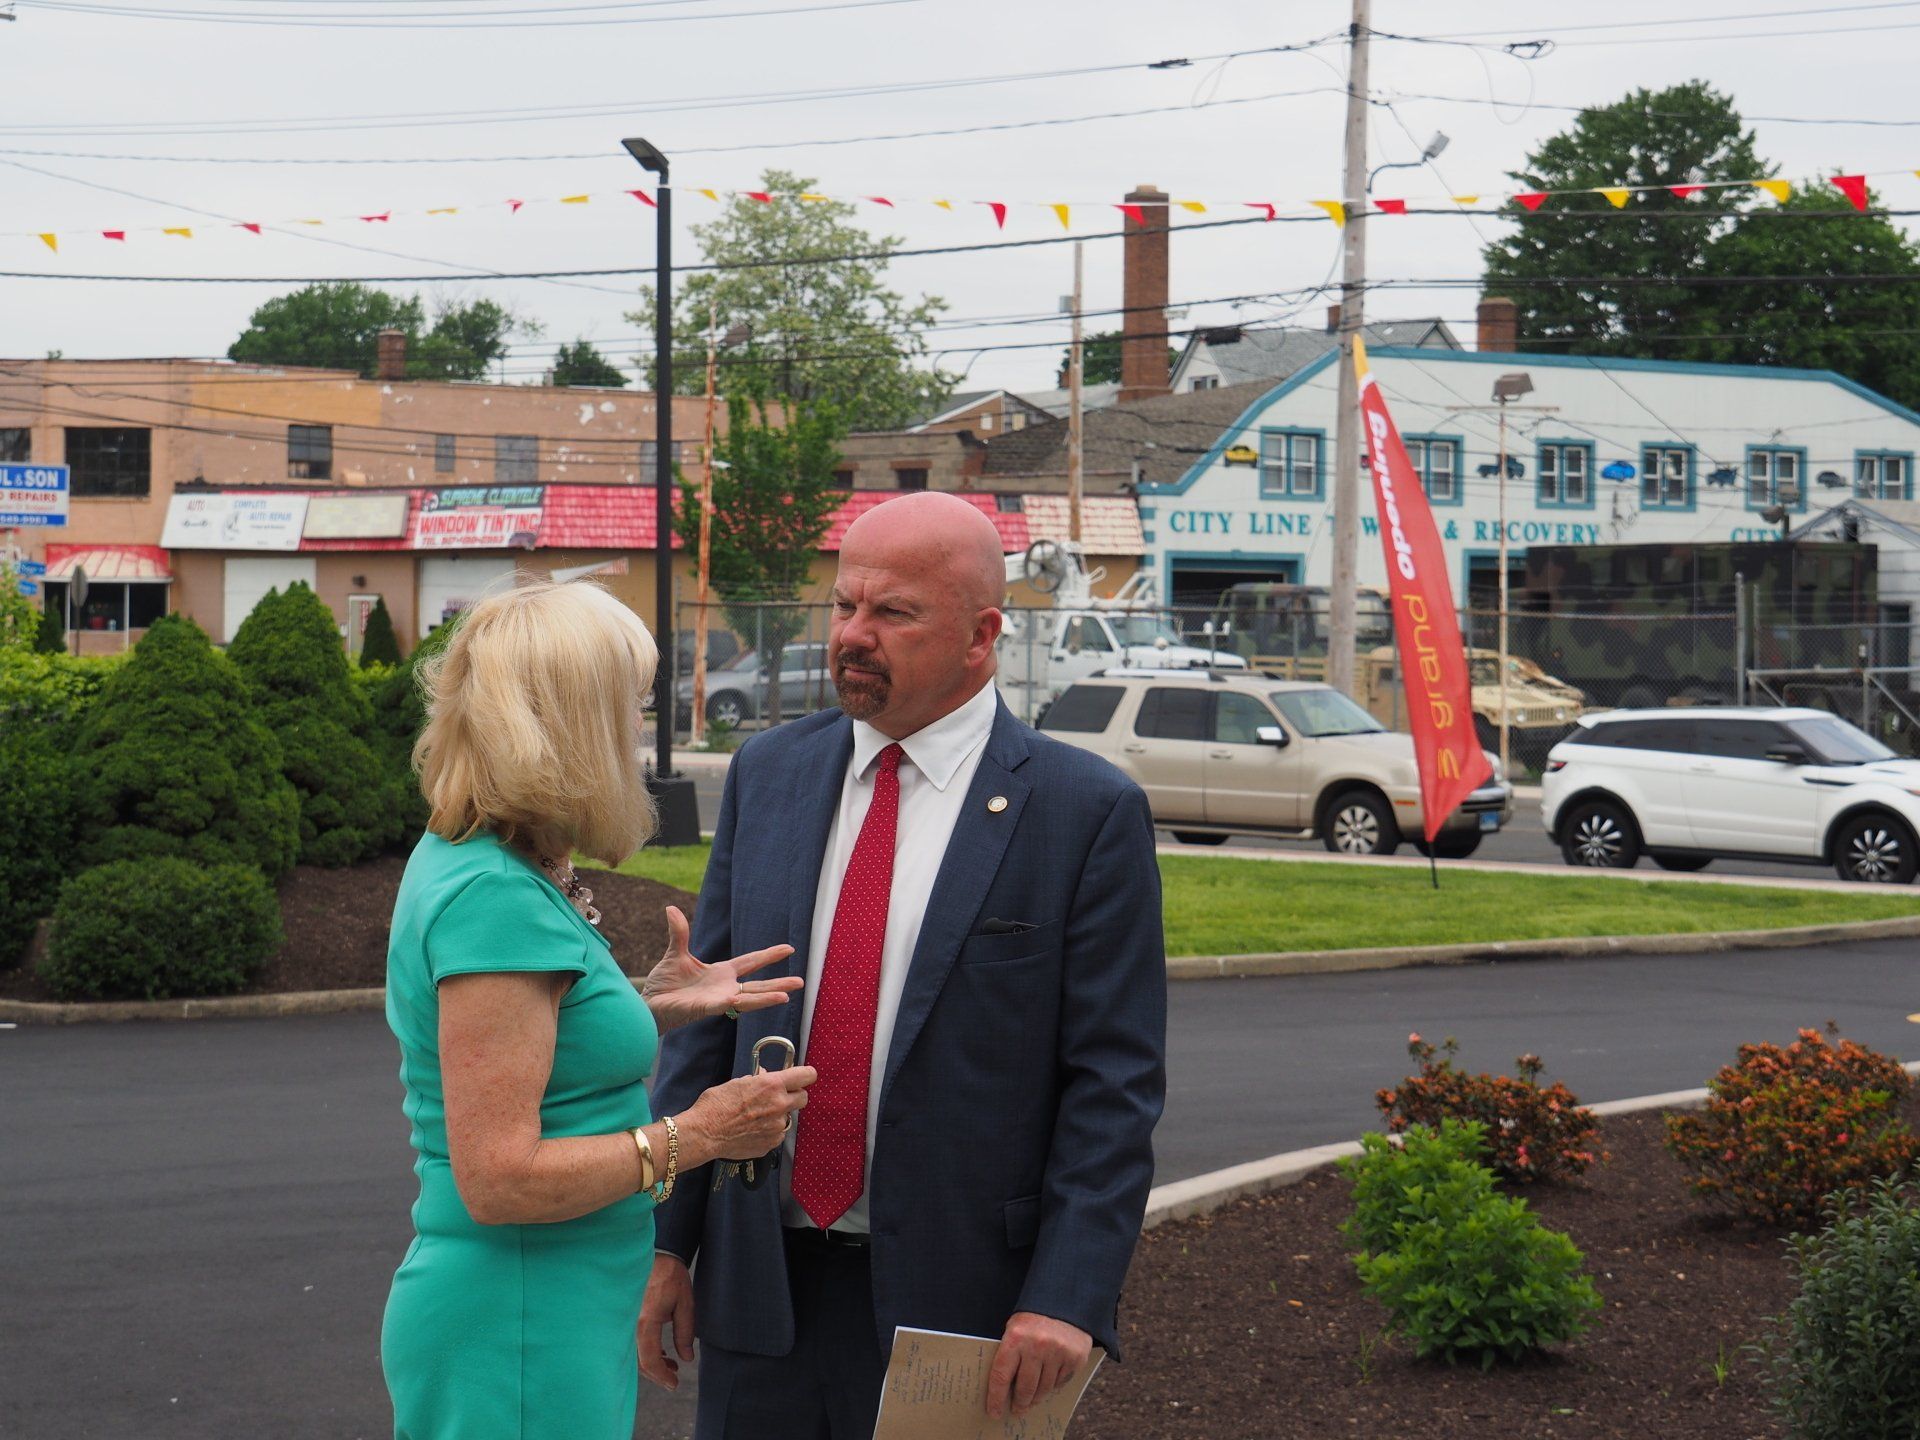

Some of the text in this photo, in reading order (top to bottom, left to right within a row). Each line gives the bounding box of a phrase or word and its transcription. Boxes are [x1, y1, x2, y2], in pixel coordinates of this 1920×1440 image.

[24, 469, 58, 488] SON
[9, 491, 57, 502] REPAIRS
[186, 499, 205, 512] AUTO
[234, 500, 267, 509] COMPLETE
[269, 512, 292, 521] REPAIR
[420, 516, 480, 534] WINDOW
[1169, 511, 1233, 534] CITY
[1249, 512, 1311, 535] LINE
[1443, 520, 1458, 540] &
[1474, 521, 1600, 544] RECOVERY
[1367, 410, 1454, 729] grand opening
